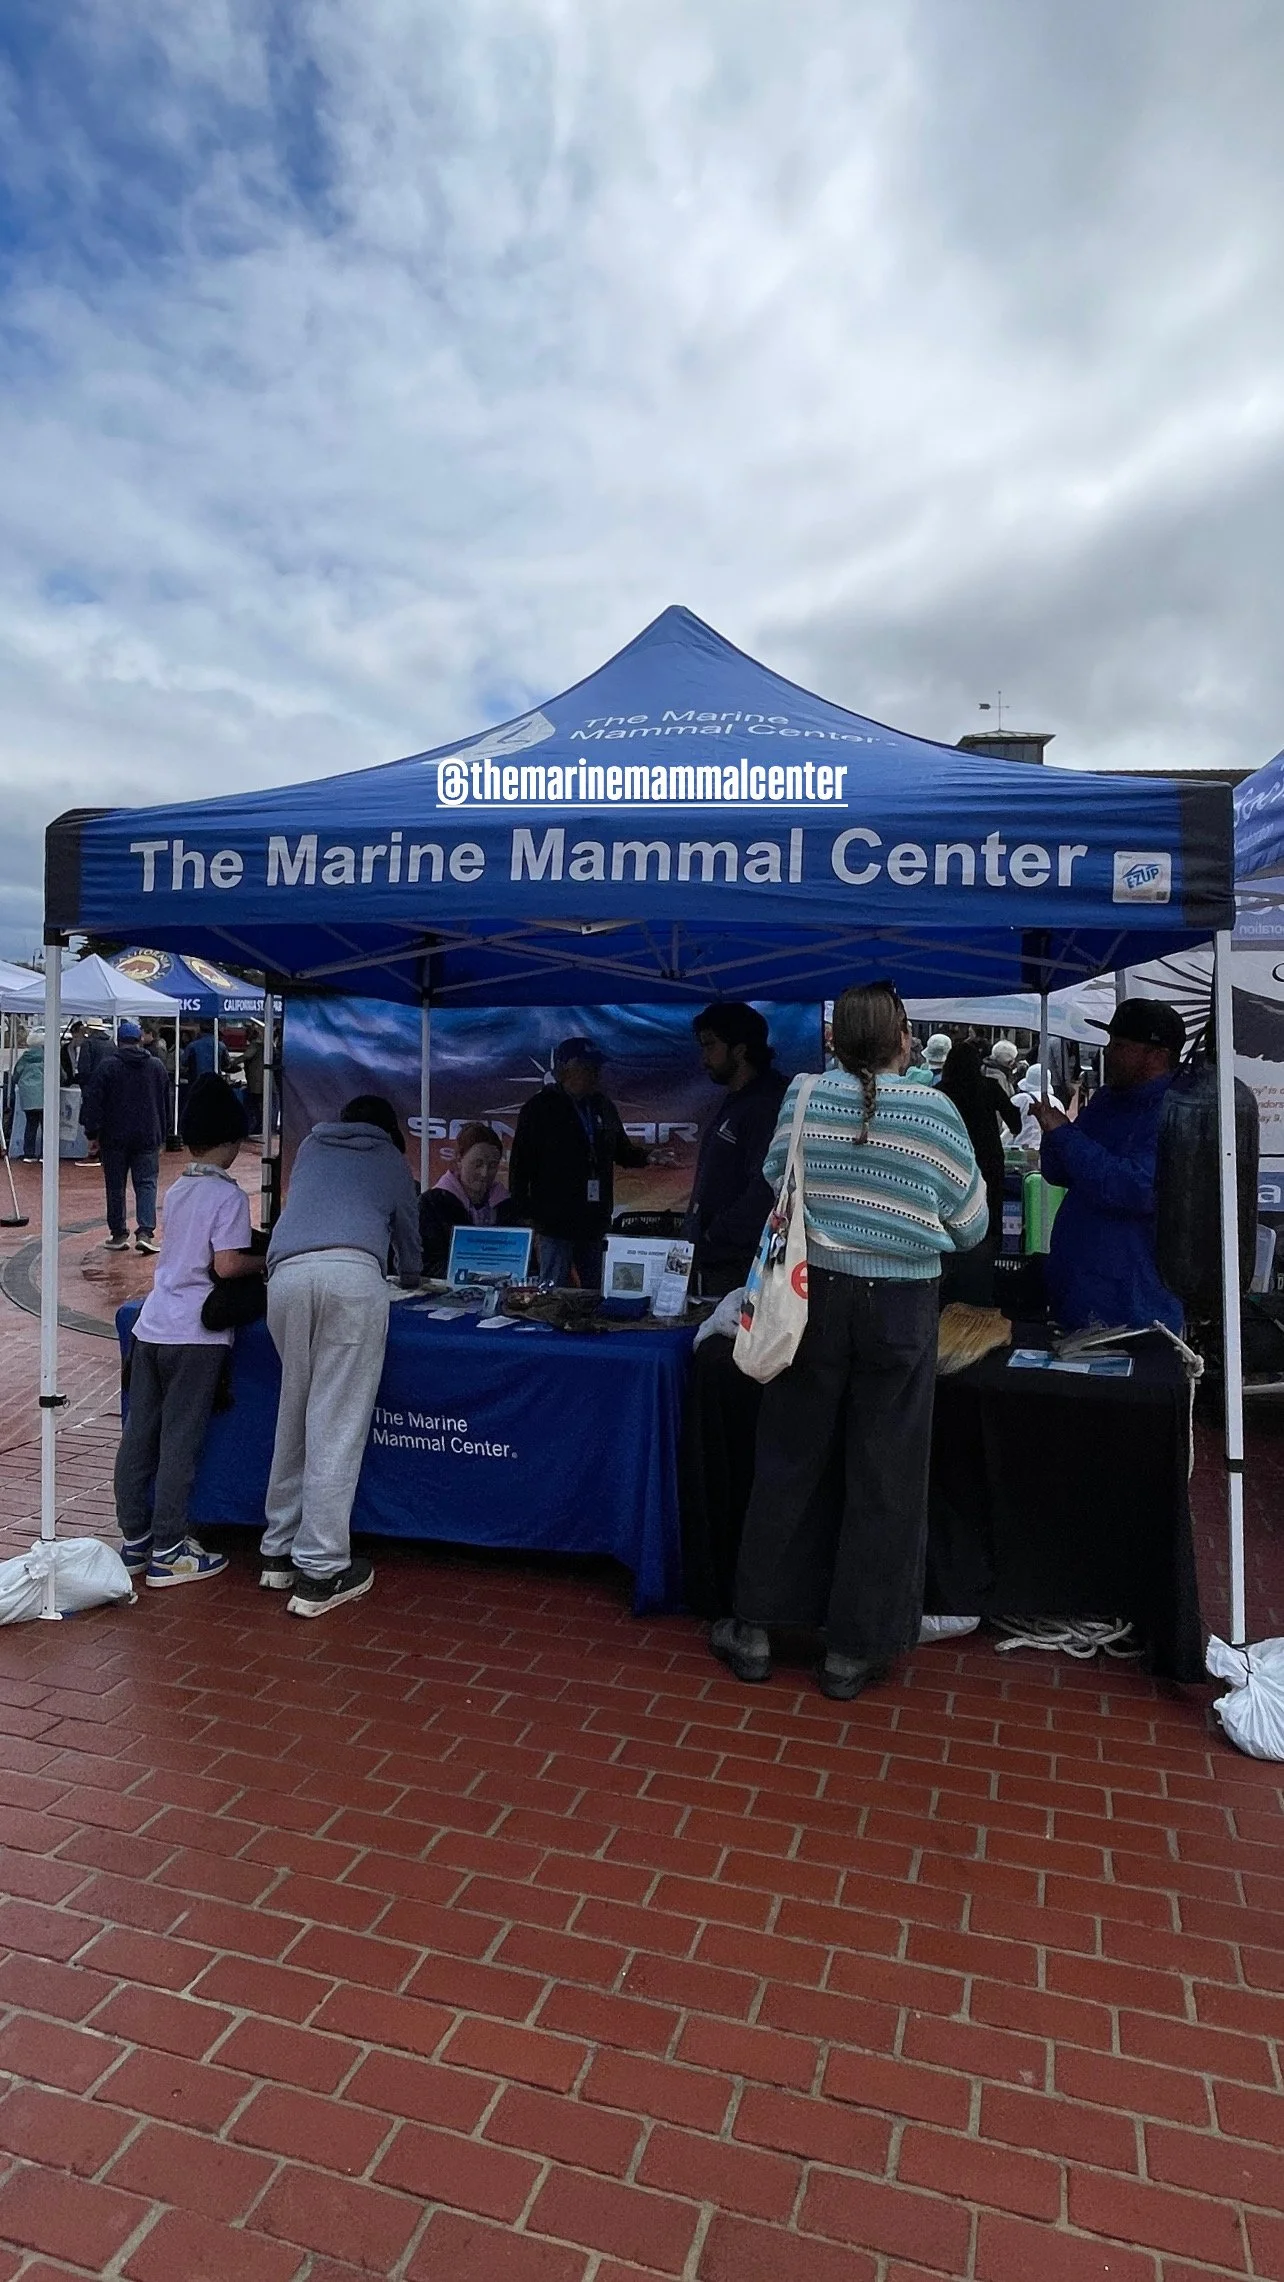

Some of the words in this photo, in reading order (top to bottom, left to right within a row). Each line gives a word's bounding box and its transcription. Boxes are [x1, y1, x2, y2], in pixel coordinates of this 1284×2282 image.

[583, 712, 649, 729] The
[661, 710, 790, 725] Marine
[569, 723, 732, 741] Mammal
[747, 723, 881, 744] Center
[130, 839, 244, 892] The
[266, 831, 485, 887] Marine
[510, 828, 803, 883] Mammal
[831, 828, 1088, 888] Center
[374, 1407, 404, 1426] The
[408, 1411, 468, 1433] Marine
[373, 1428, 446, 1452] Mammal
